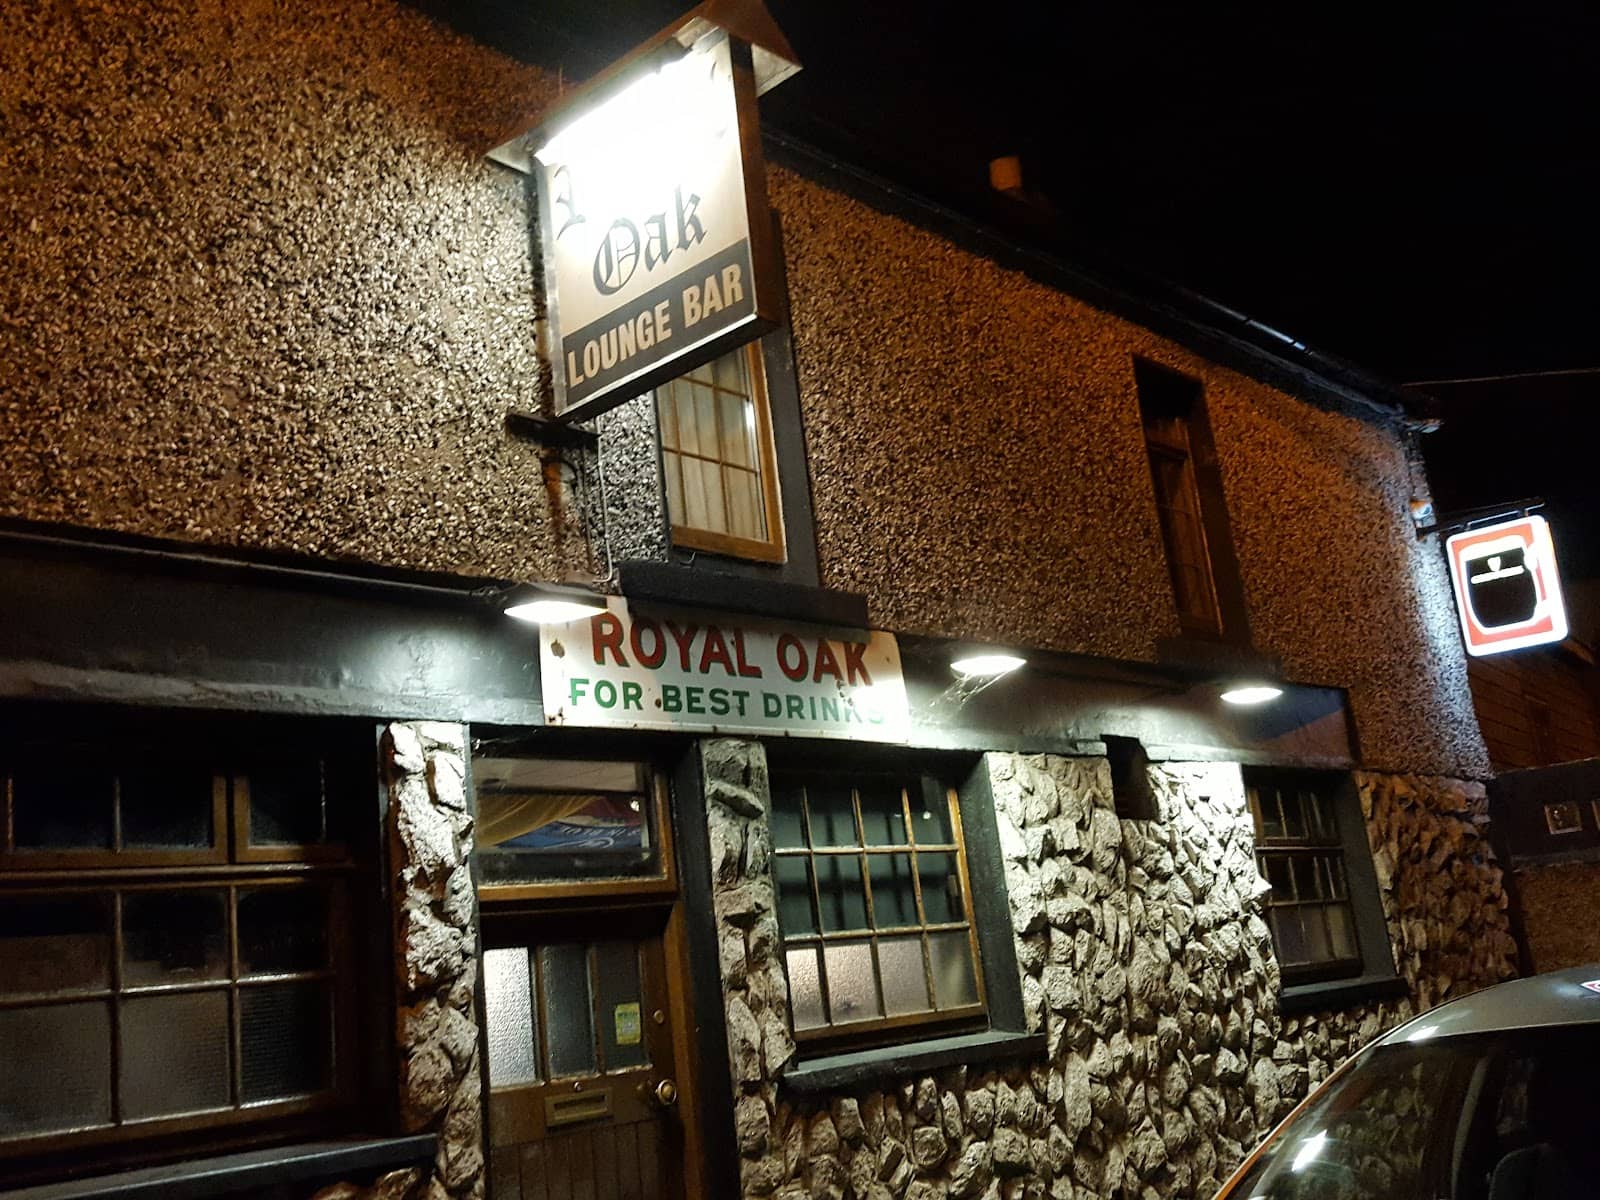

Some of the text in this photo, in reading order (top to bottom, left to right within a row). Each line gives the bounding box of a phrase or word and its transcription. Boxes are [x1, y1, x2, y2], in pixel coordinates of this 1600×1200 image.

[594, 184, 707, 295] Oak
[569, 264, 744, 387] LOUNGE BAR
[591, 612, 873, 687] ROYAL OAK
[569, 678, 643, 710] FOR
[662, 685, 750, 717] BEST
